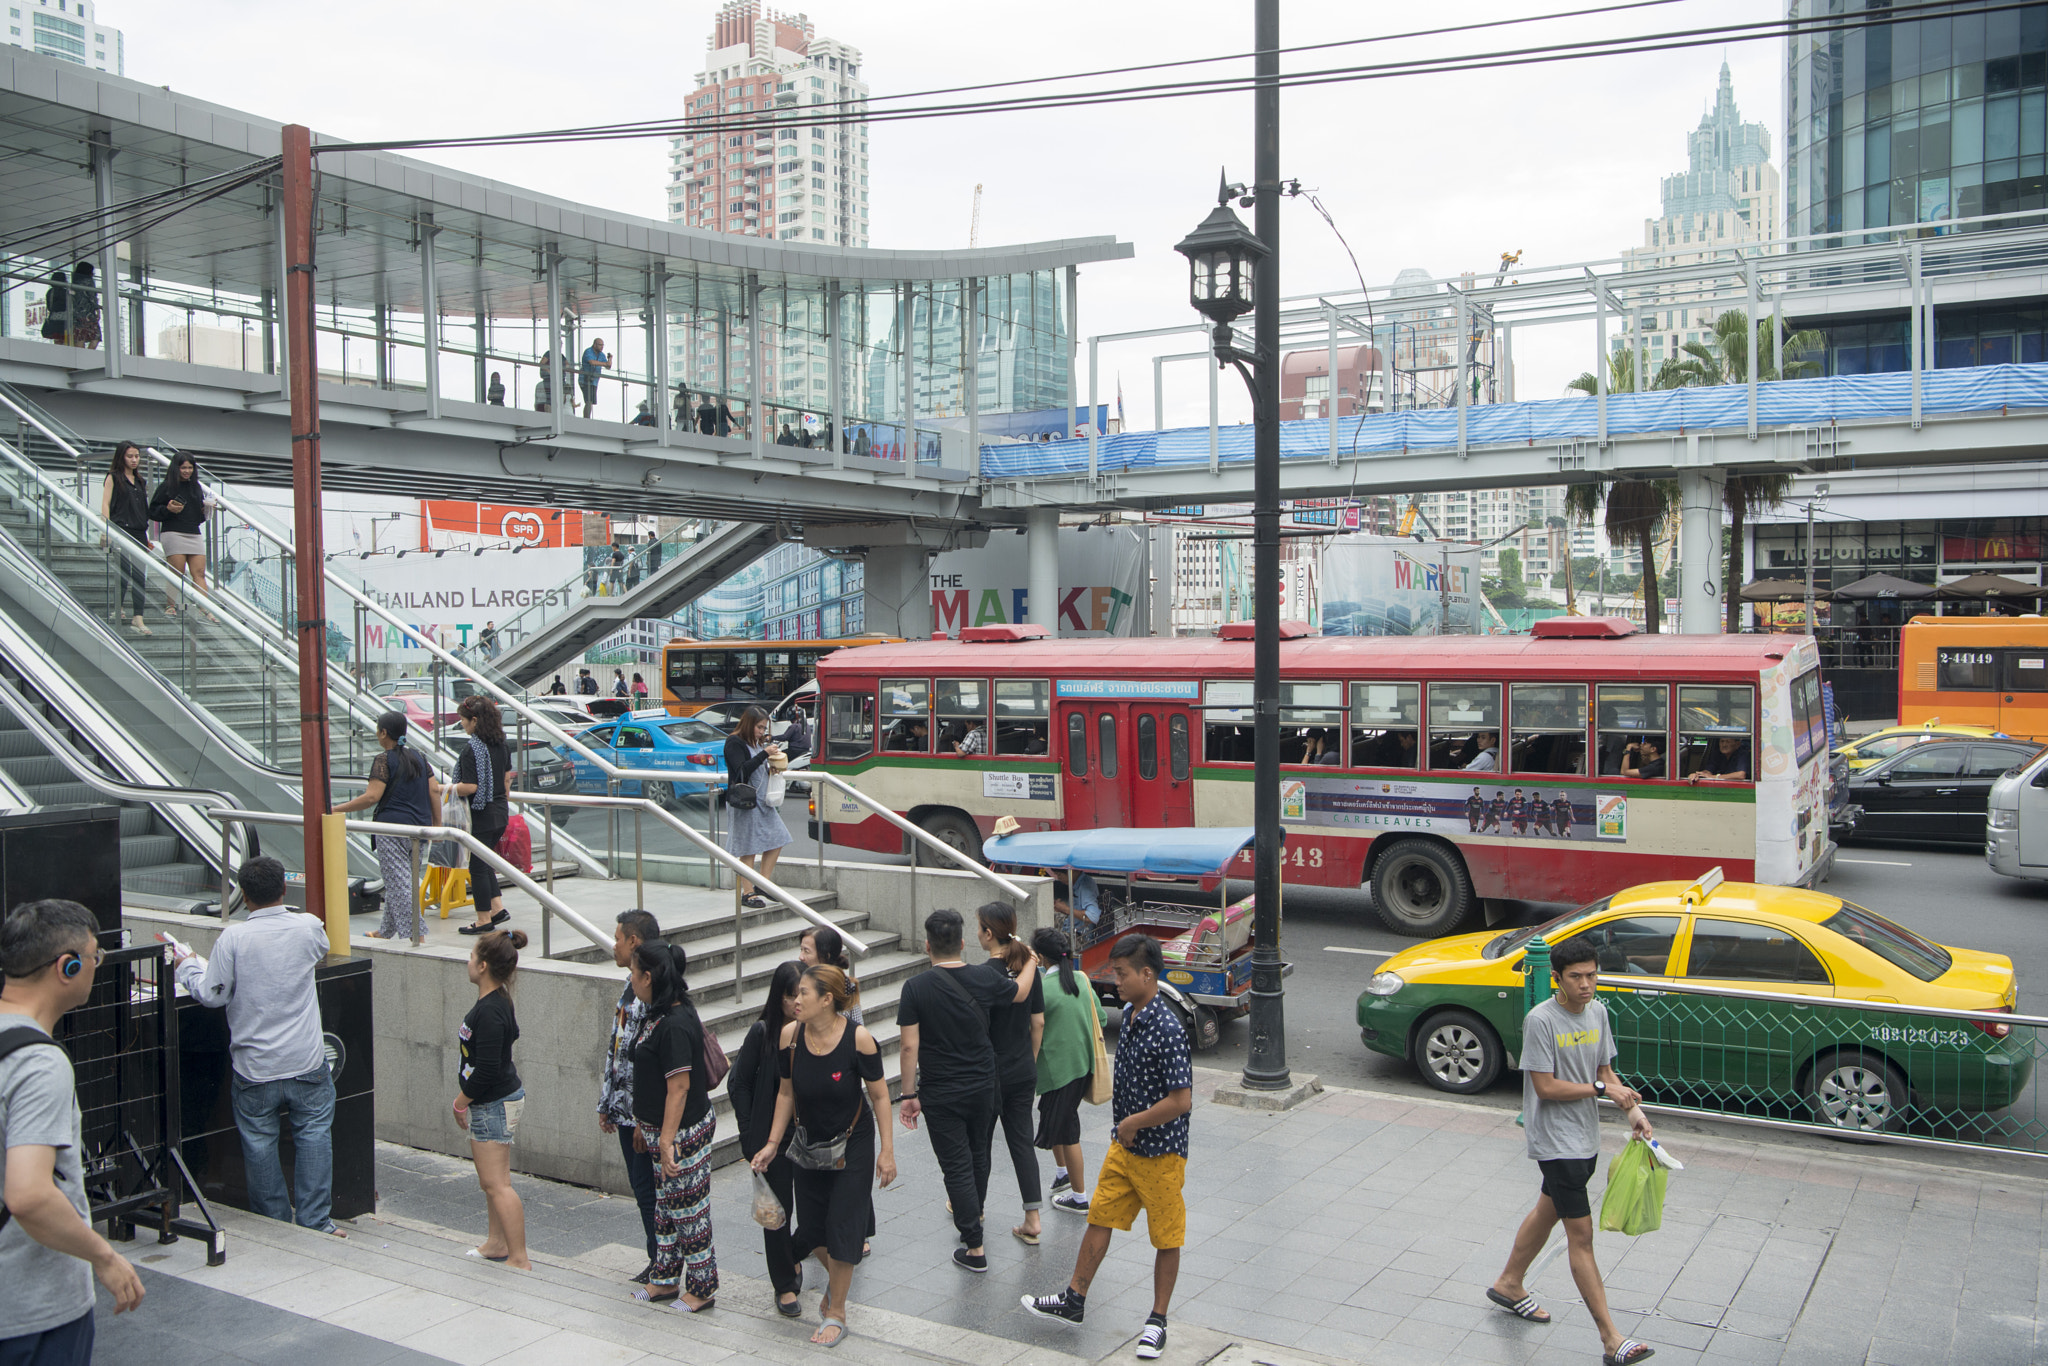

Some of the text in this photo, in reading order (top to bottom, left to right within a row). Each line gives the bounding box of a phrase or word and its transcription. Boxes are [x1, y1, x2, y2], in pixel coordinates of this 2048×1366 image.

[512, 524, 534, 535] SPR
[930, 574, 963, 588] THE
[1394, 560, 1469, 594] MARKET
[1940, 652, 1993, 664] 2-44149
[988, 773, 1009, 781] Shuttle
